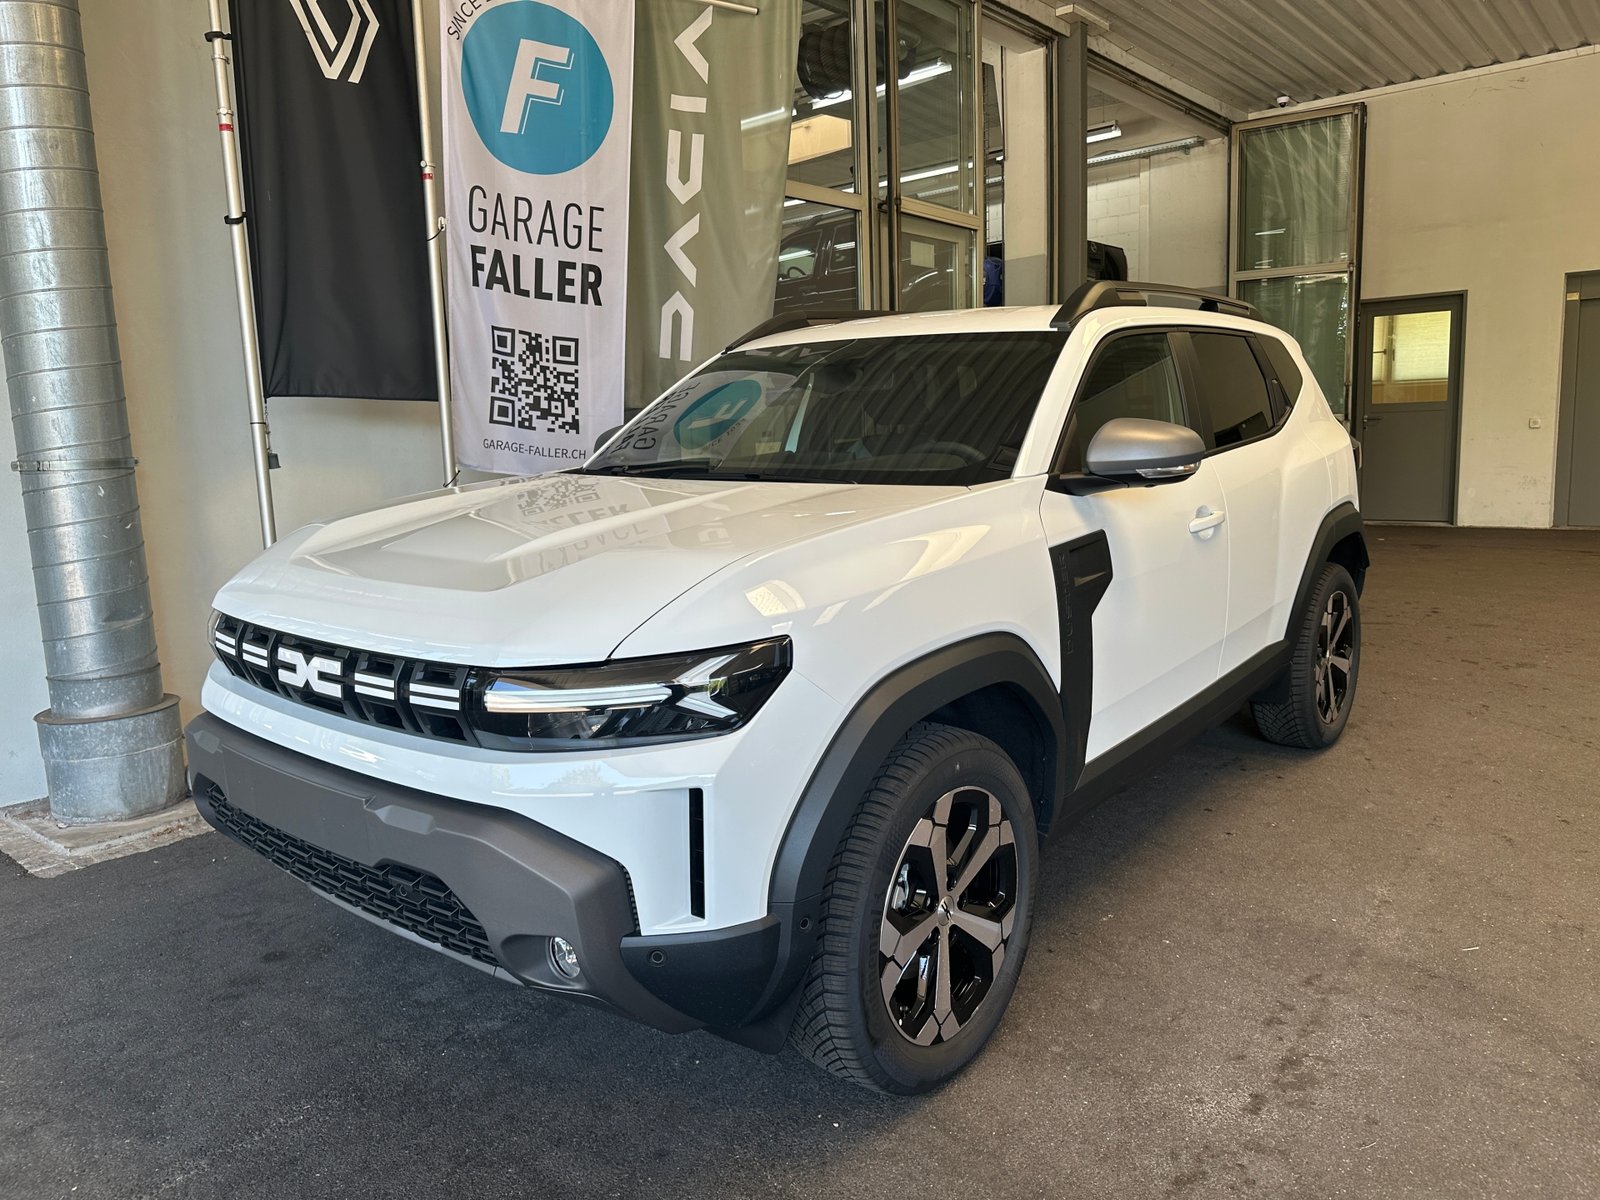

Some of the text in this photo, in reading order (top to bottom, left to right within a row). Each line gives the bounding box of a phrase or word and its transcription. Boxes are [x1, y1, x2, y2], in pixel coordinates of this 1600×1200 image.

[499, 38, 575, 135] F
[468, 184, 605, 253] GARAGE
[470, 244, 603, 307] FALLER
[482, 437, 588, 460] GARAGE-FALLER.CH
